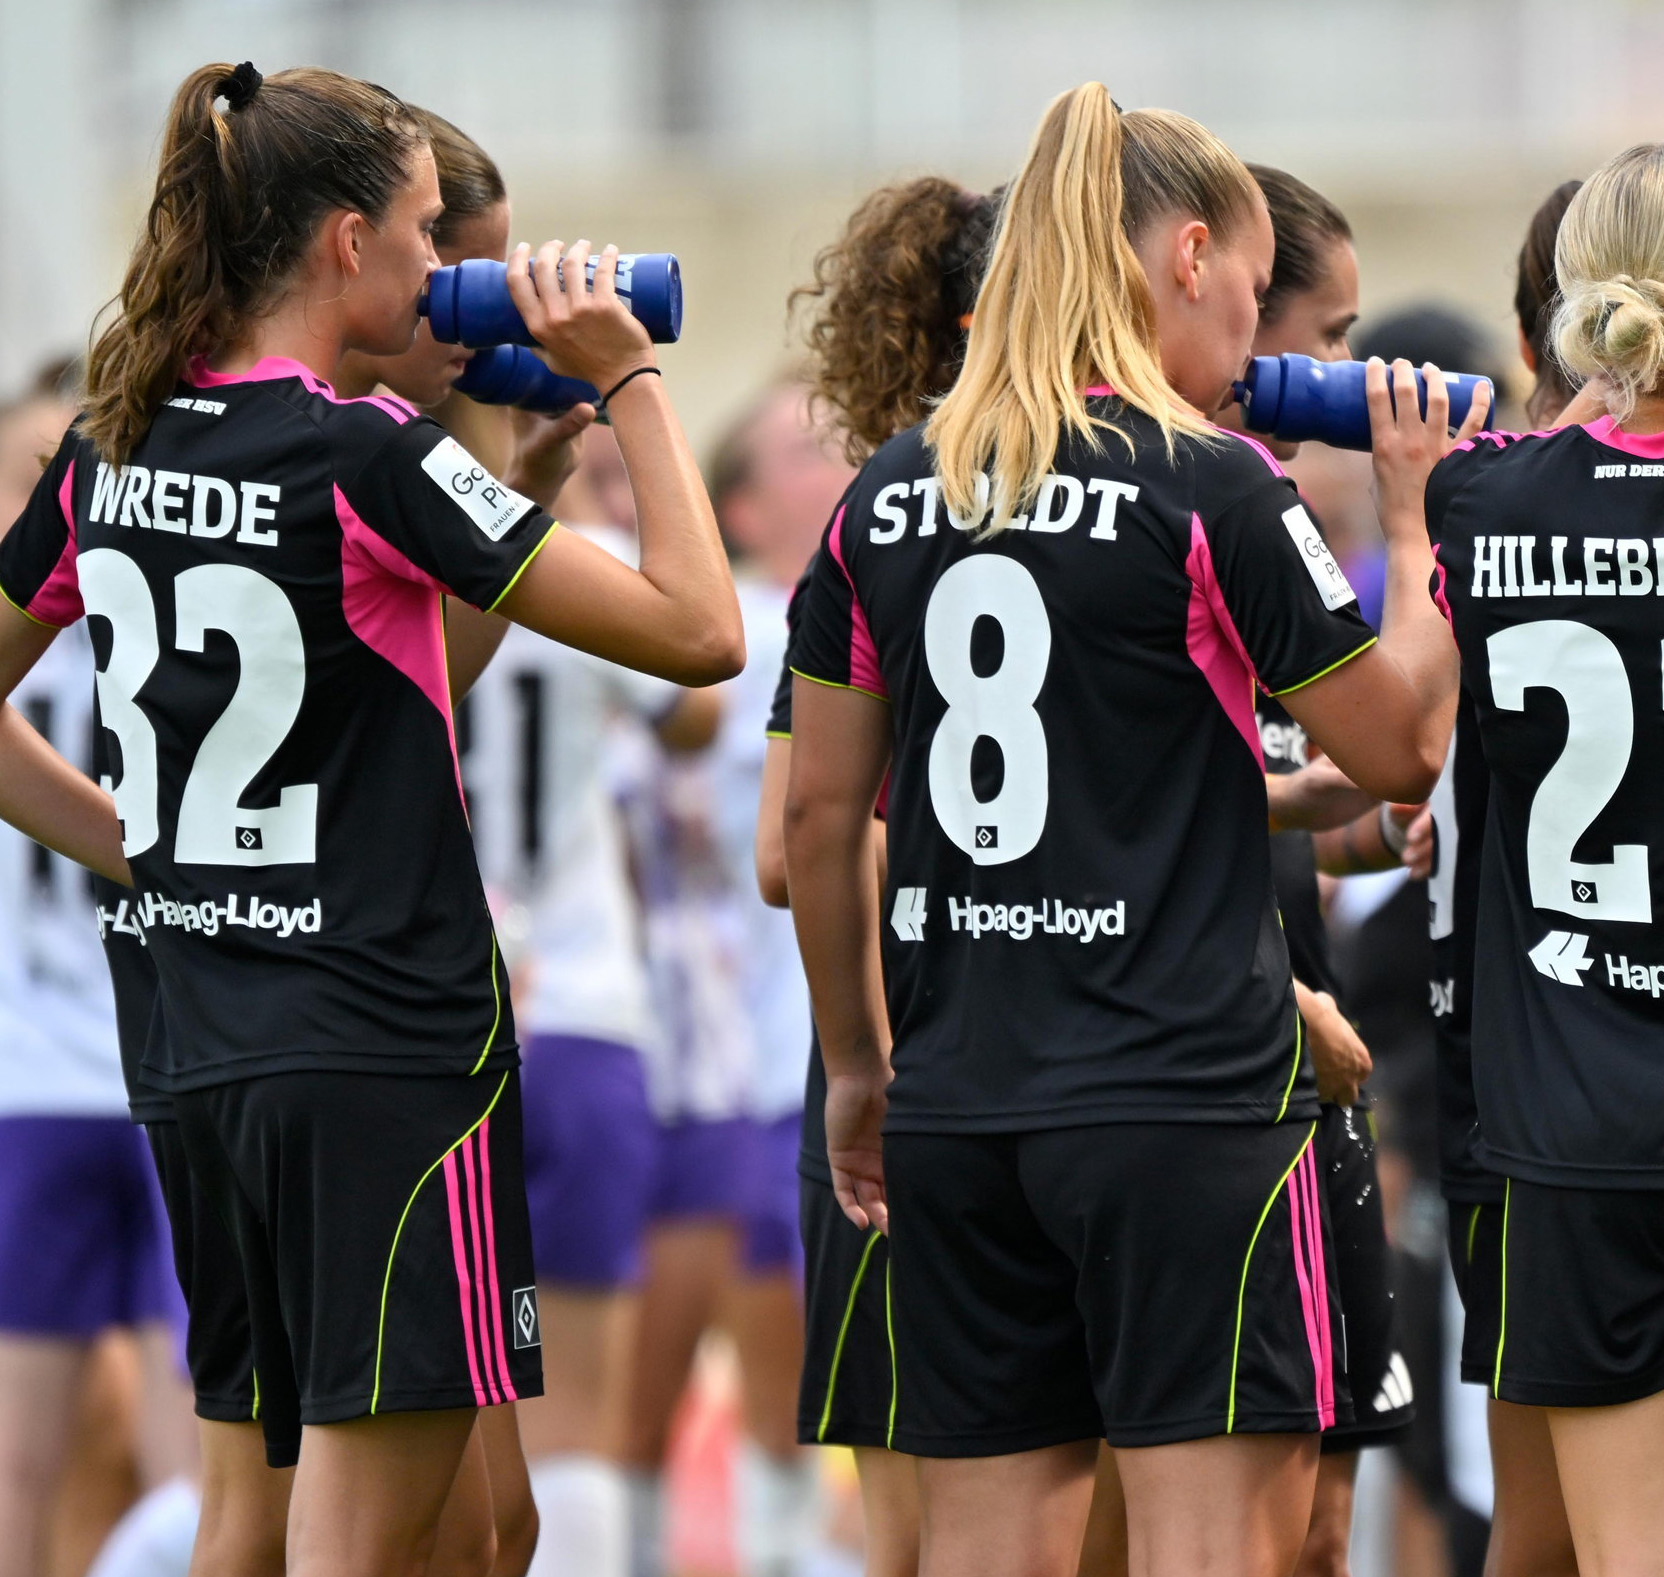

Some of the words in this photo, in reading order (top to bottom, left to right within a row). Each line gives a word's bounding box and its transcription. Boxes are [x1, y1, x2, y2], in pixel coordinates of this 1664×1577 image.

[192, 399, 227, 415] HSV
[452, 467, 485, 495] Go
[1594, 464, 1627, 479] NUR
[1629, 464, 1664, 477] DER
[88, 461, 281, 547] WREDE
[481, 481, 508, 509] Pi
[924, 553, 1051, 866] 8
[948, 896, 1125, 943] Hpag-Lloyd
